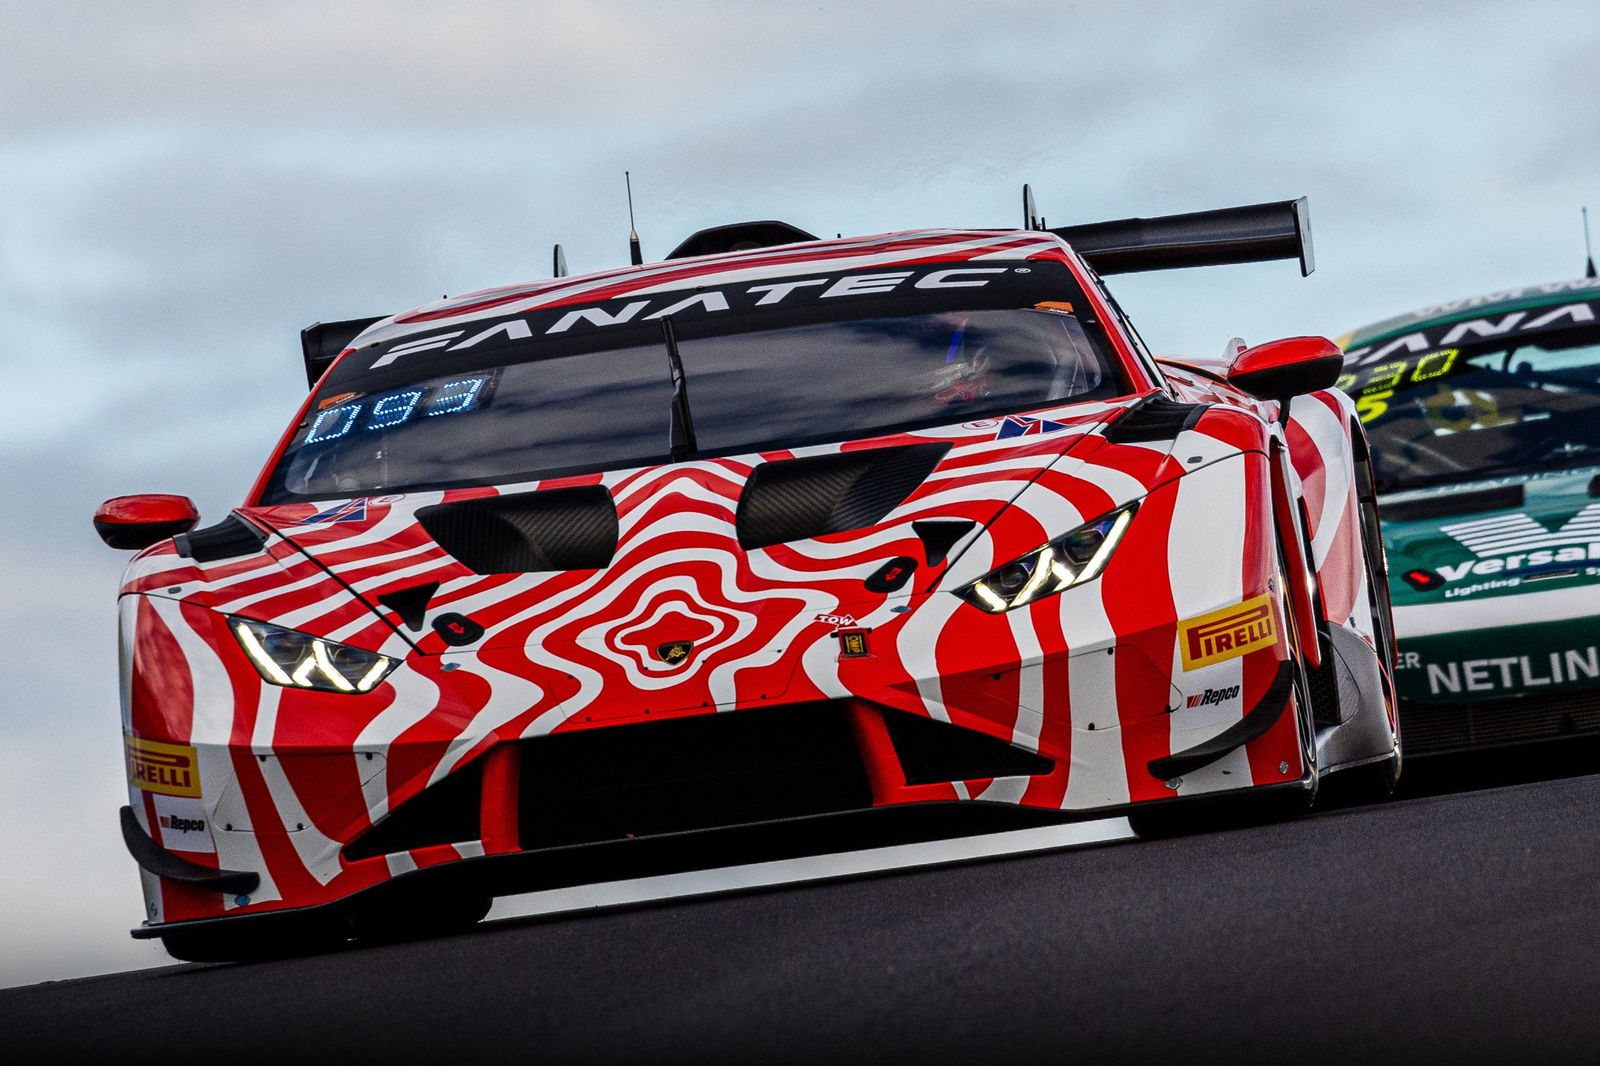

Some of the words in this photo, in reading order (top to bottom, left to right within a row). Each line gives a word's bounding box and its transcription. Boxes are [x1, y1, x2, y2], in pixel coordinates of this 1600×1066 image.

[304, 378, 483, 445] 093
[1444, 577, 1521, 598] Lighting
[819, 615, 854, 625] TOW
[1186, 604, 1273, 661] PIRELLI
[1426, 646, 1600, 694] NETLIN
[1200, 685, 1240, 706] Repco
[170, 815, 205, 834] Repco
